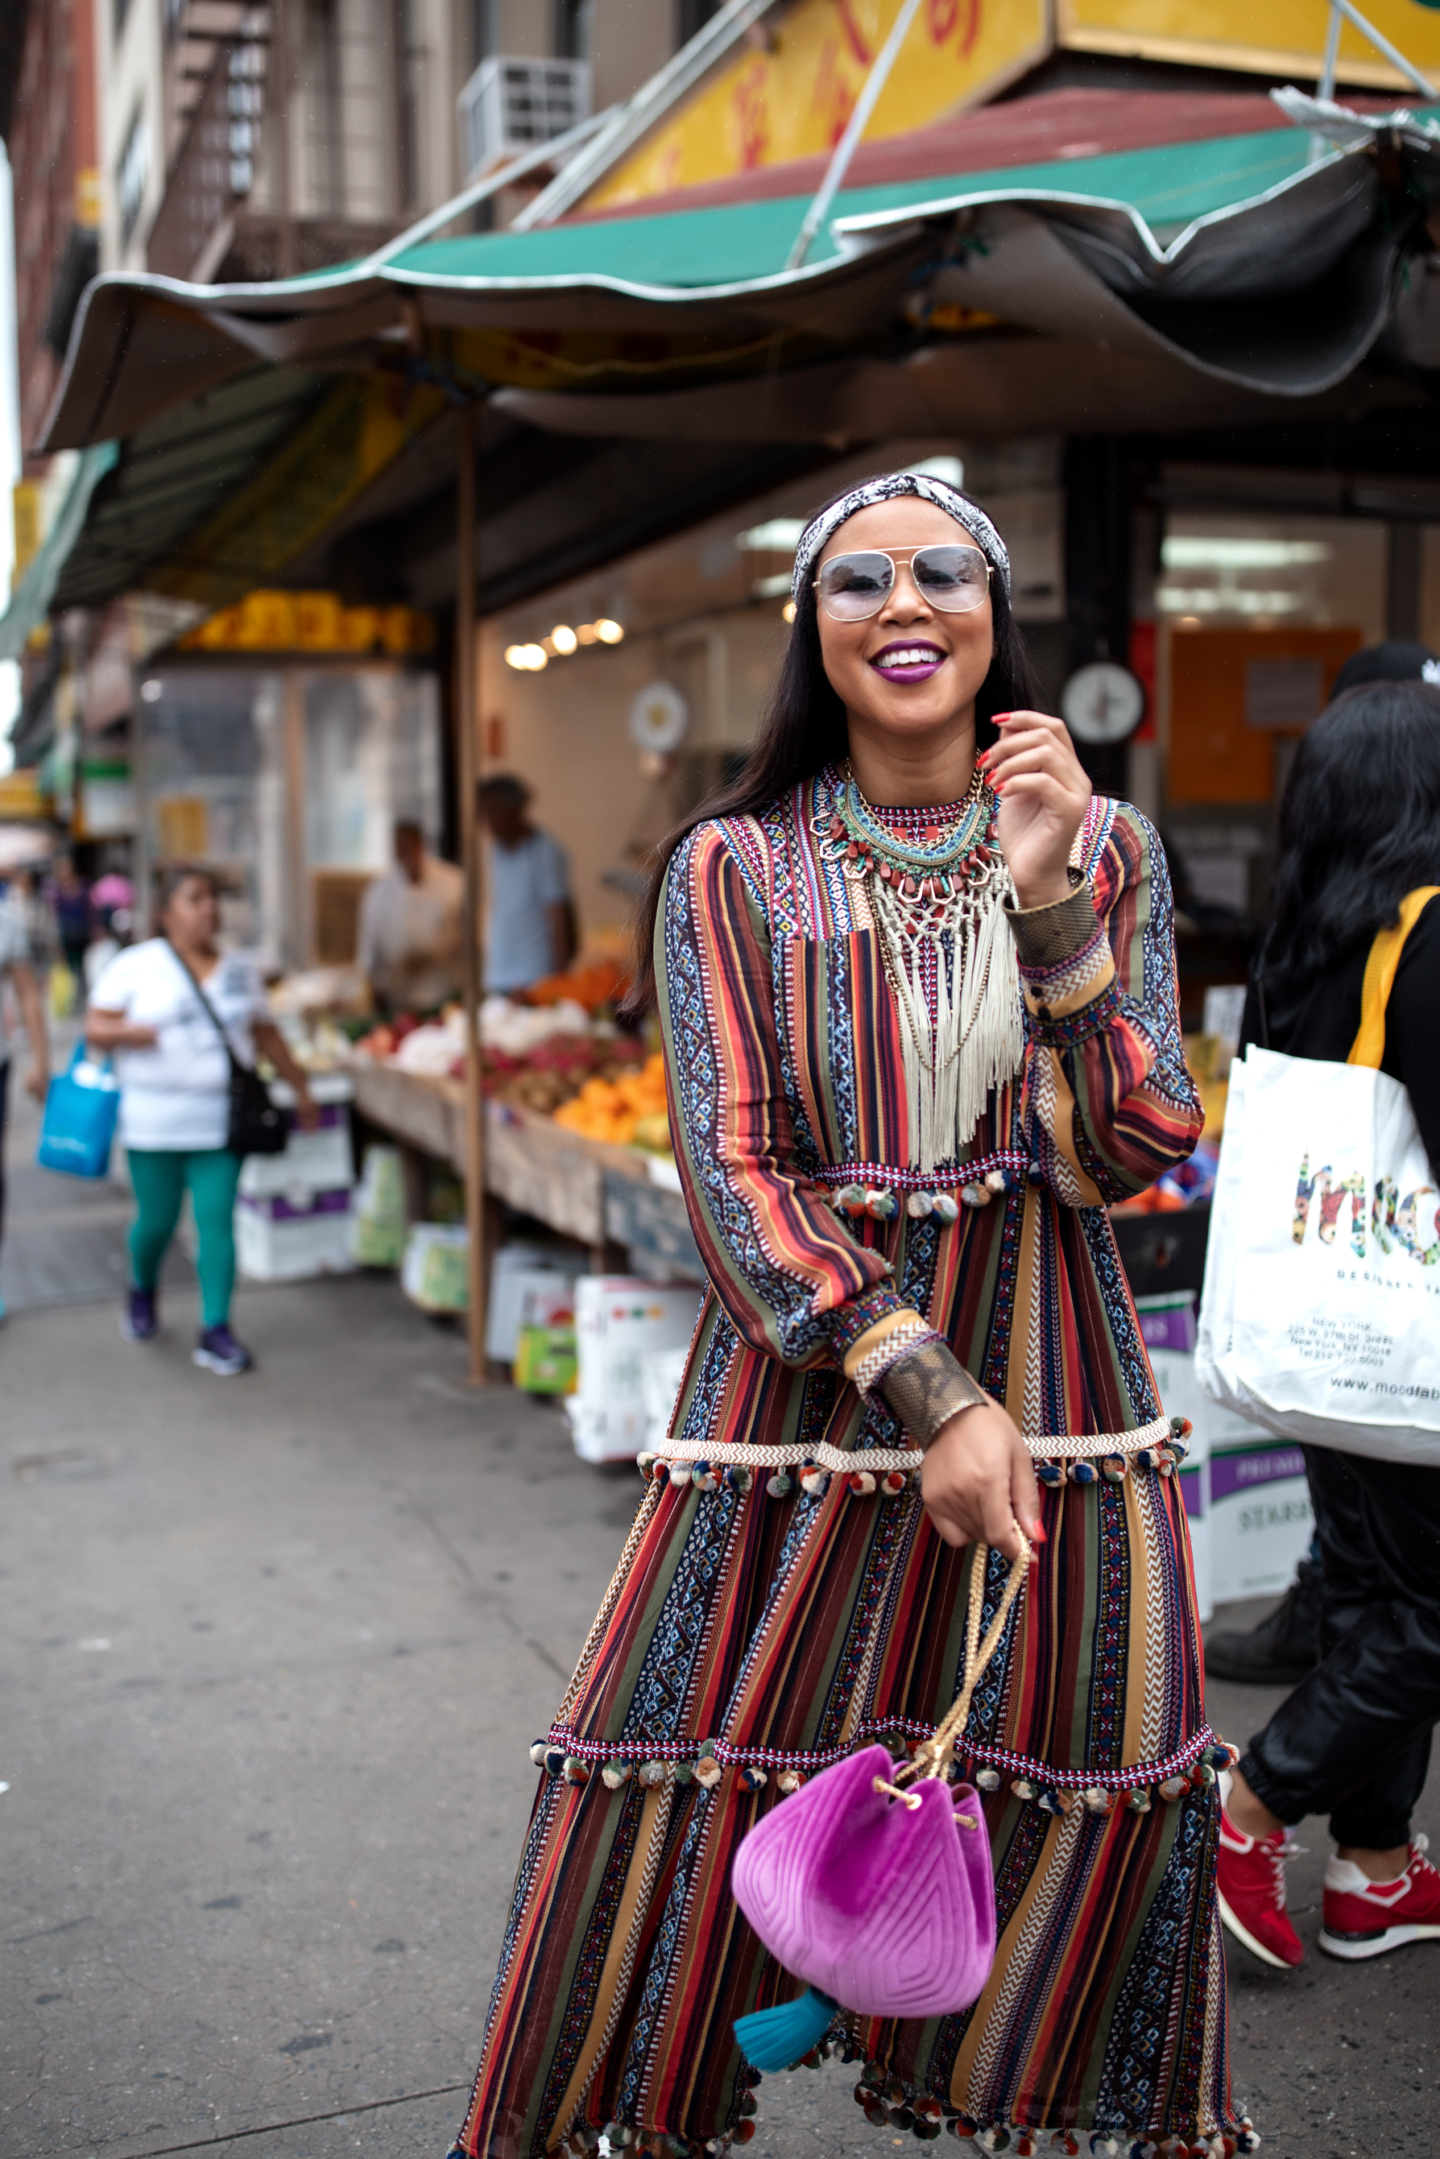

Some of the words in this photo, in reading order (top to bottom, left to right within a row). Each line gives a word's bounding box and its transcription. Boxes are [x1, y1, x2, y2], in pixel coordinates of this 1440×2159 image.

[1312, 1317, 1337, 1328] NEW
[1341, 1320, 1372, 1331] YORK
[1290, 1335, 1312, 1346] New
[1343, 1342, 1359, 1352] NY
